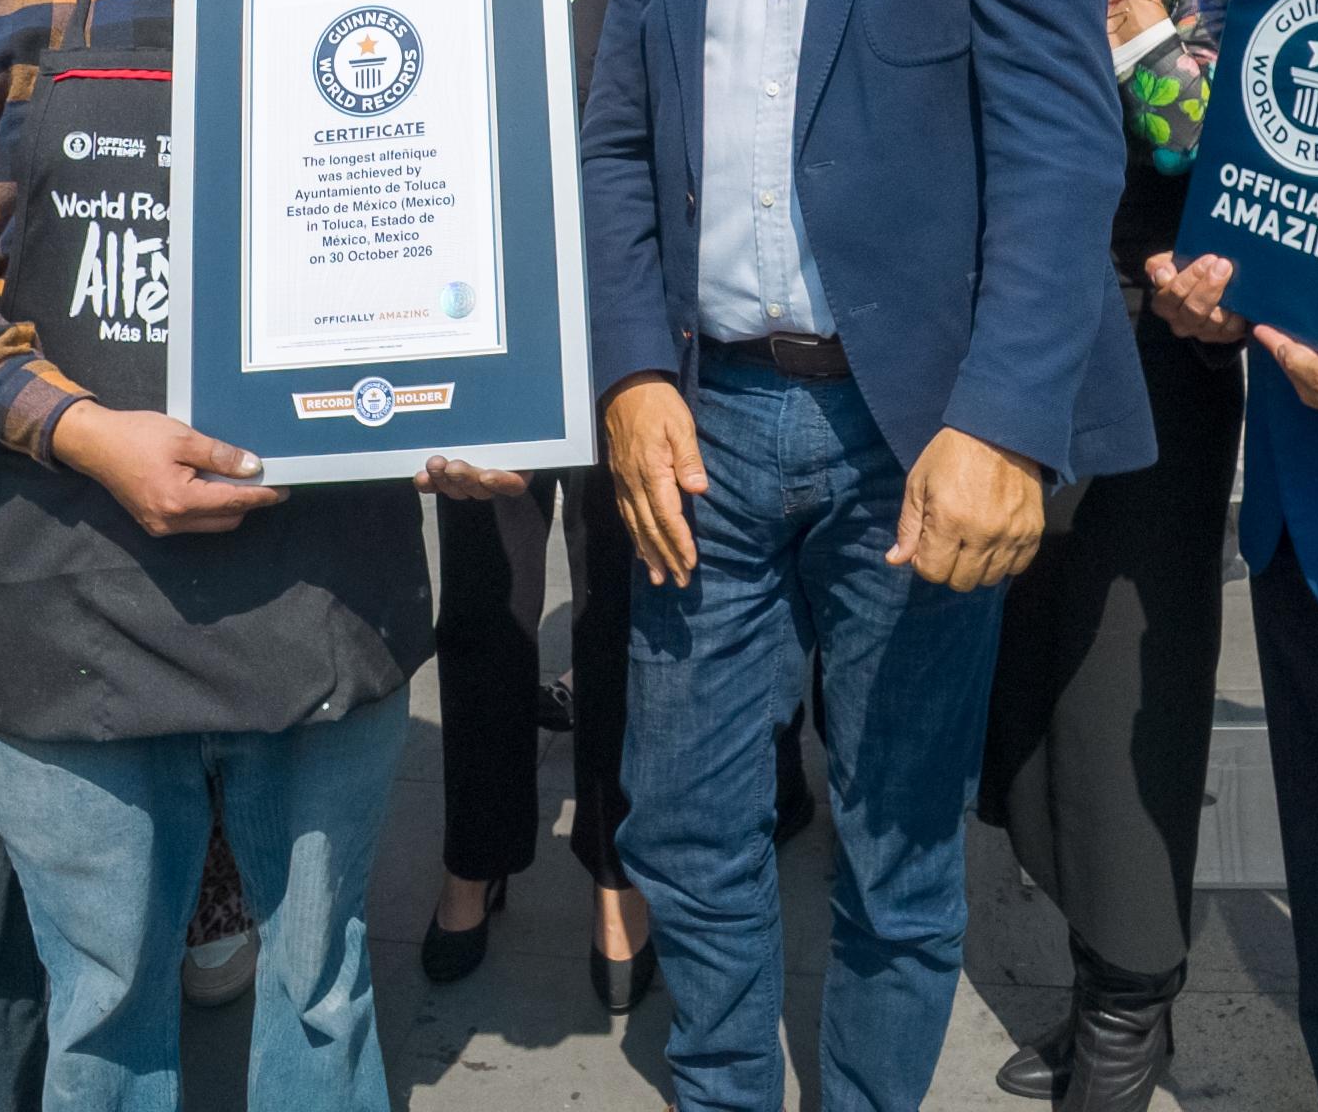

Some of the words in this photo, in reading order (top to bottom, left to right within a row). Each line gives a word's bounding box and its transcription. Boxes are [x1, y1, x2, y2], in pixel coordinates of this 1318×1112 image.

[328, 11, 408, 44] GUINNESS
[319, 57, 357, 108] WORLD
[361, 49, 418, 111] RECORDS
[1252, 54, 1289, 145] WORLD
[96, 136, 146, 149] OFFICIAL
[313, 121, 426, 143] CERTIFICATE
[96, 147, 146, 159] ATTEMPT
[302, 156, 326, 168] The
[329, 152, 375, 167] longest
[379, 147, 438, 162] alfeñique
[317, 172, 343, 183] was
[346, 165, 402, 180] achieved
[406, 163, 422, 177] by
[294, 185, 382, 202] Ayuntamiento
[385, 182, 401, 194] de
[404, 179, 447, 192] Toluca
[50, 190, 125, 221] World
[286, 203, 330, 218] Estado
[333, 201, 349, 214] de
[352, 199, 397, 213] México
[401, 193, 456, 211] (Mexico)
[306, 220, 318, 232] in
[322, 217, 367, 232] Toluca,
[371, 213, 416, 227] Estado
[419, 212, 435, 224] de
[322, 233, 371, 248] México,
[374, 229, 420, 244] Mexico
[309, 255, 325, 265] on
[329, 251, 344, 264] 30
[348, 248, 399, 262] October
[402, 244, 433, 258] 2026
[314, 312, 375, 325] OFFICIALLY
[378, 308, 430, 321] AMAZING
[99, 319, 141, 342] Más
[306, 397, 352, 410] RECORD
[396, 391, 443, 404] HOLDER
